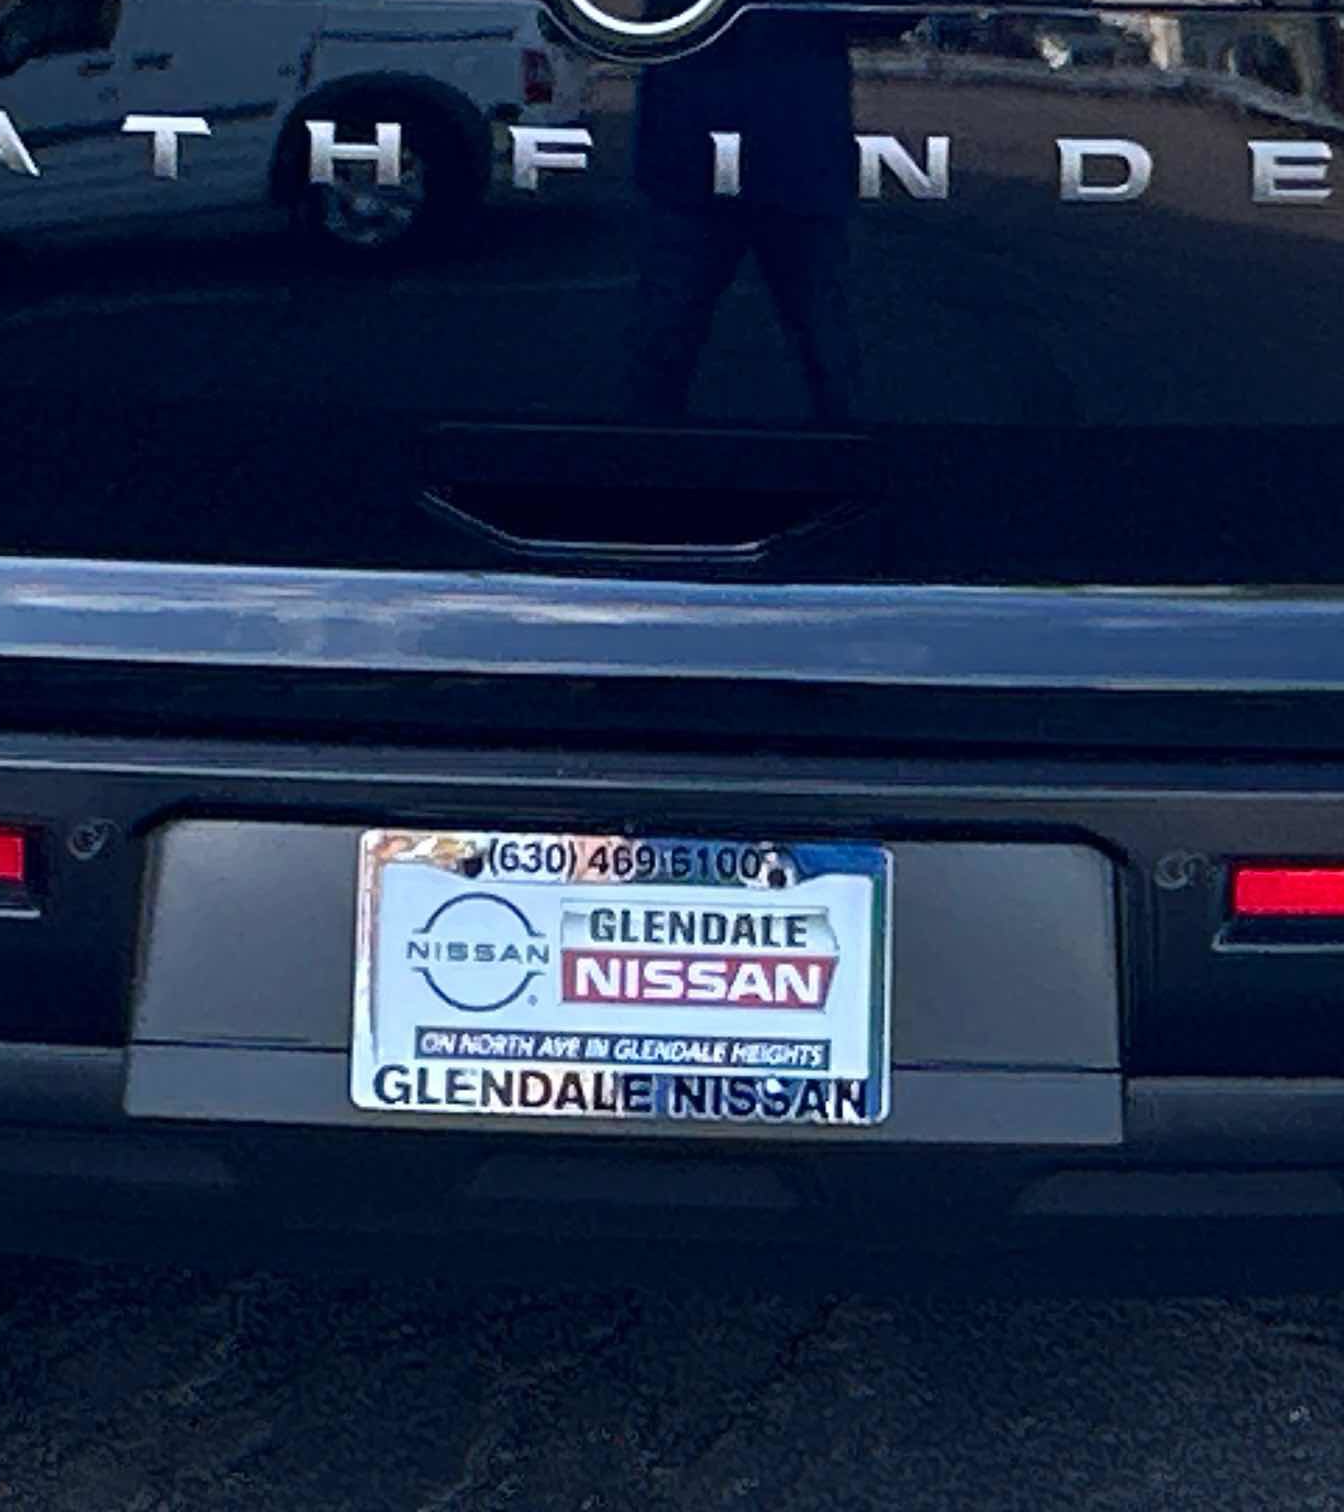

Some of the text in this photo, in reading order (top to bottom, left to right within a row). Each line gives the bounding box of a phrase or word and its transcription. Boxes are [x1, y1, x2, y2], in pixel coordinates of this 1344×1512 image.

[489, 838, 578, 877] (630)
[588, 907, 808, 949] GLENDALE
[405, 940, 551, 965] NISSAN
[575, 956, 824, 1003] NISSAN
[421, 1031, 457, 1055] ON
[458, 1033, 533, 1058] NORTH
[585, 1037, 608, 1058] IN
[612, 1038, 727, 1062] GLENDALE
[729, 1042, 825, 1067] HEIGHTS
[372, 1063, 868, 1122] GLENDALE NISSAN
